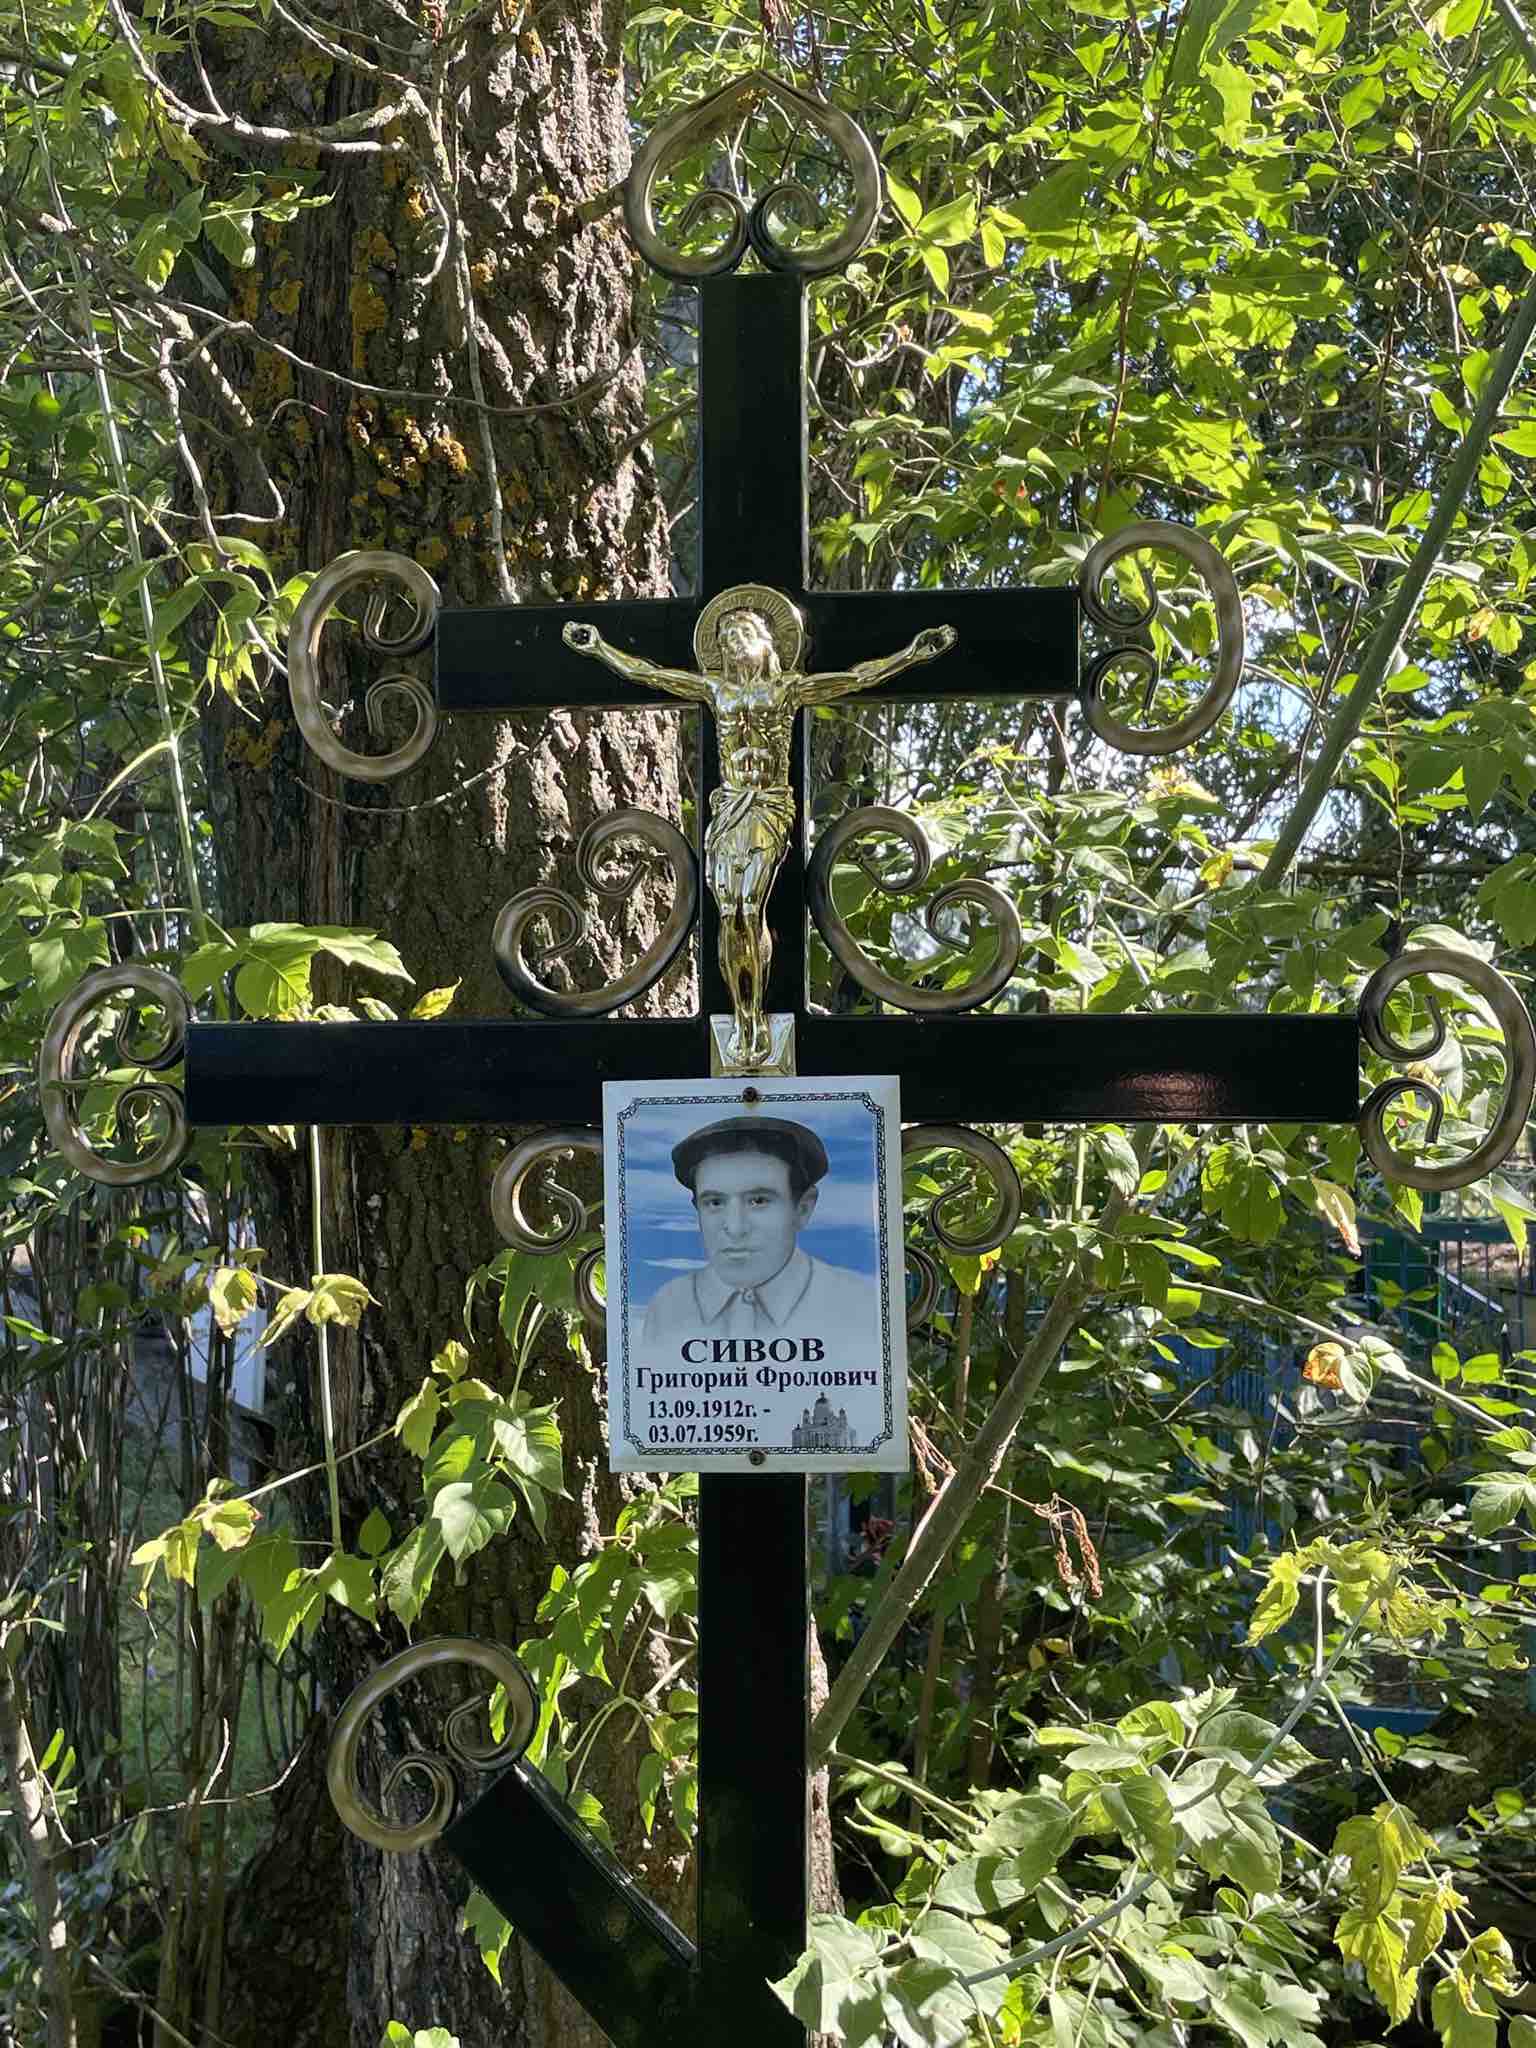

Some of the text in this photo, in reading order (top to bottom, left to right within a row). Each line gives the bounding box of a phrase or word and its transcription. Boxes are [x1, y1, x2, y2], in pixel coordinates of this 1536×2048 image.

[680, 1337, 826, 1364] СИВОВ
[636, 1366, 878, 1394] Григорий Фролович
[648, 1400, 758, 1418] 13.09.1912г.
[648, 1424, 759, 1443] 03.07.1959г.
